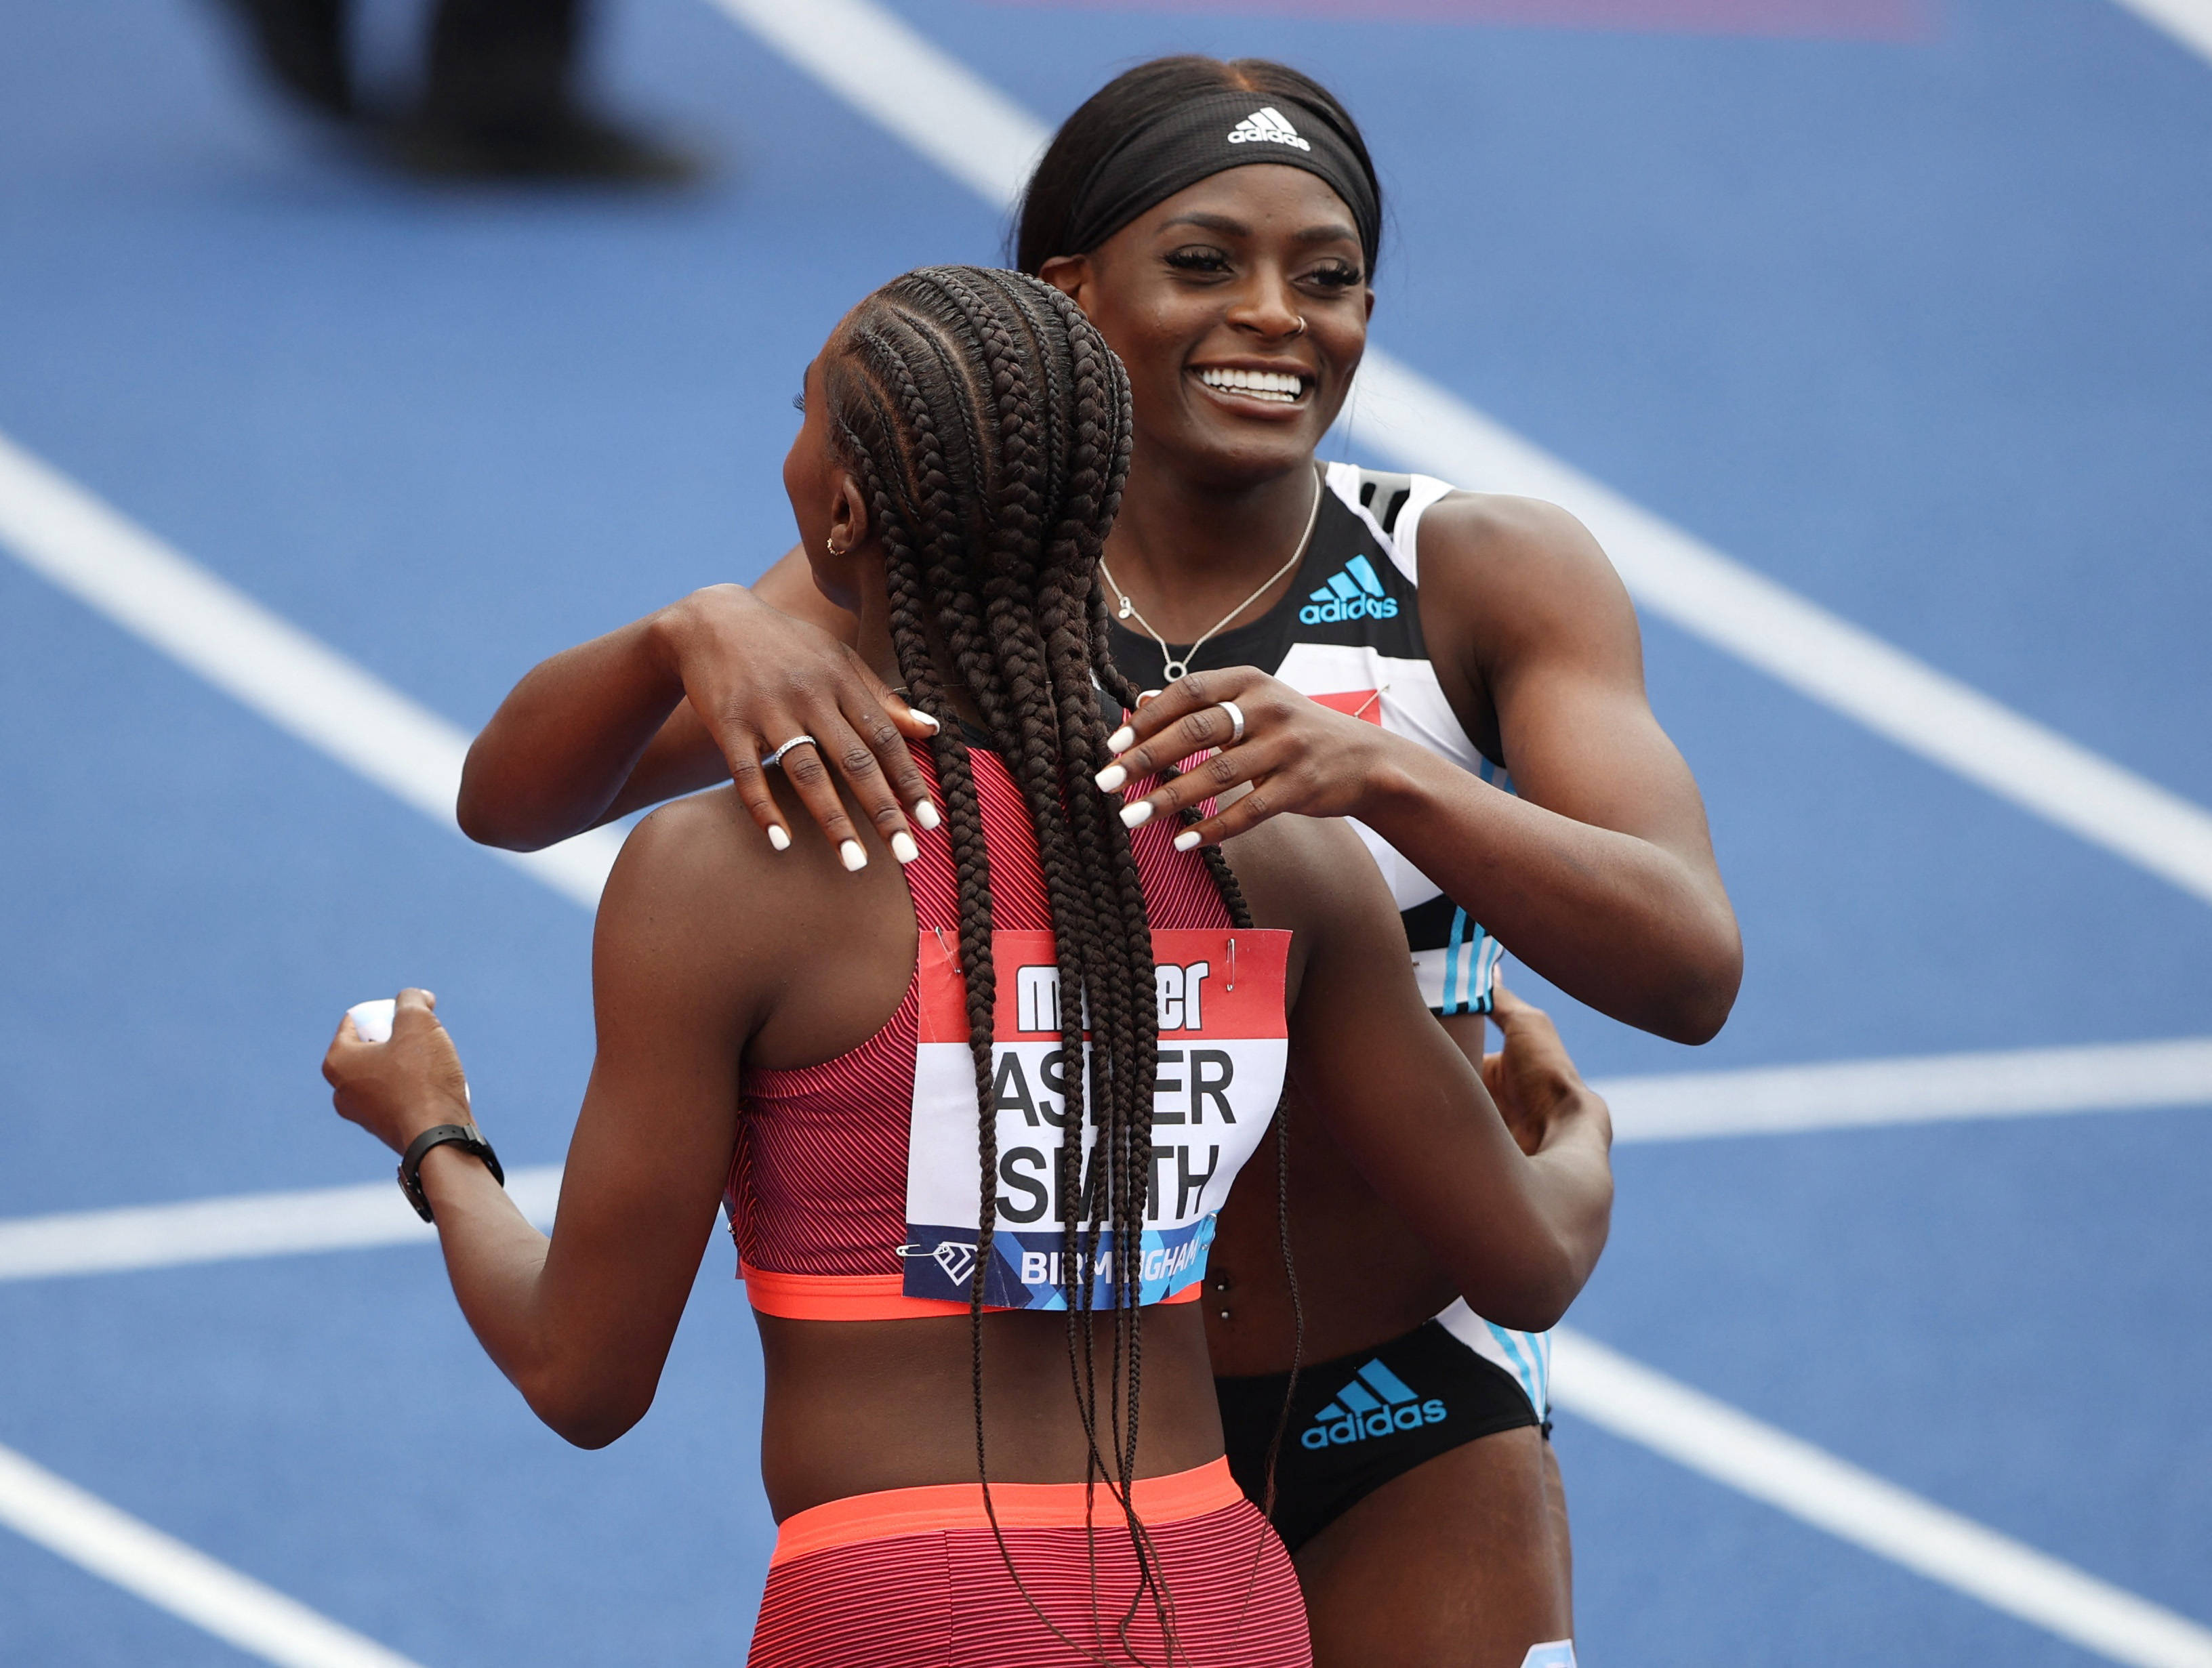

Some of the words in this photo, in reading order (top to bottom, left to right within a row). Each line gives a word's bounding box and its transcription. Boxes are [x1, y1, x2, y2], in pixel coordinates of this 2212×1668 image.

[1227, 127, 1311, 152] adidas
[1299, 591, 1399, 625] adidas
[1017, 961, 1209, 1033] mer
[991, 1049, 1237, 1127] ASER
[996, 1144, 1220, 1224] SMTH
[1301, 1398, 1448, 1450] adidas
